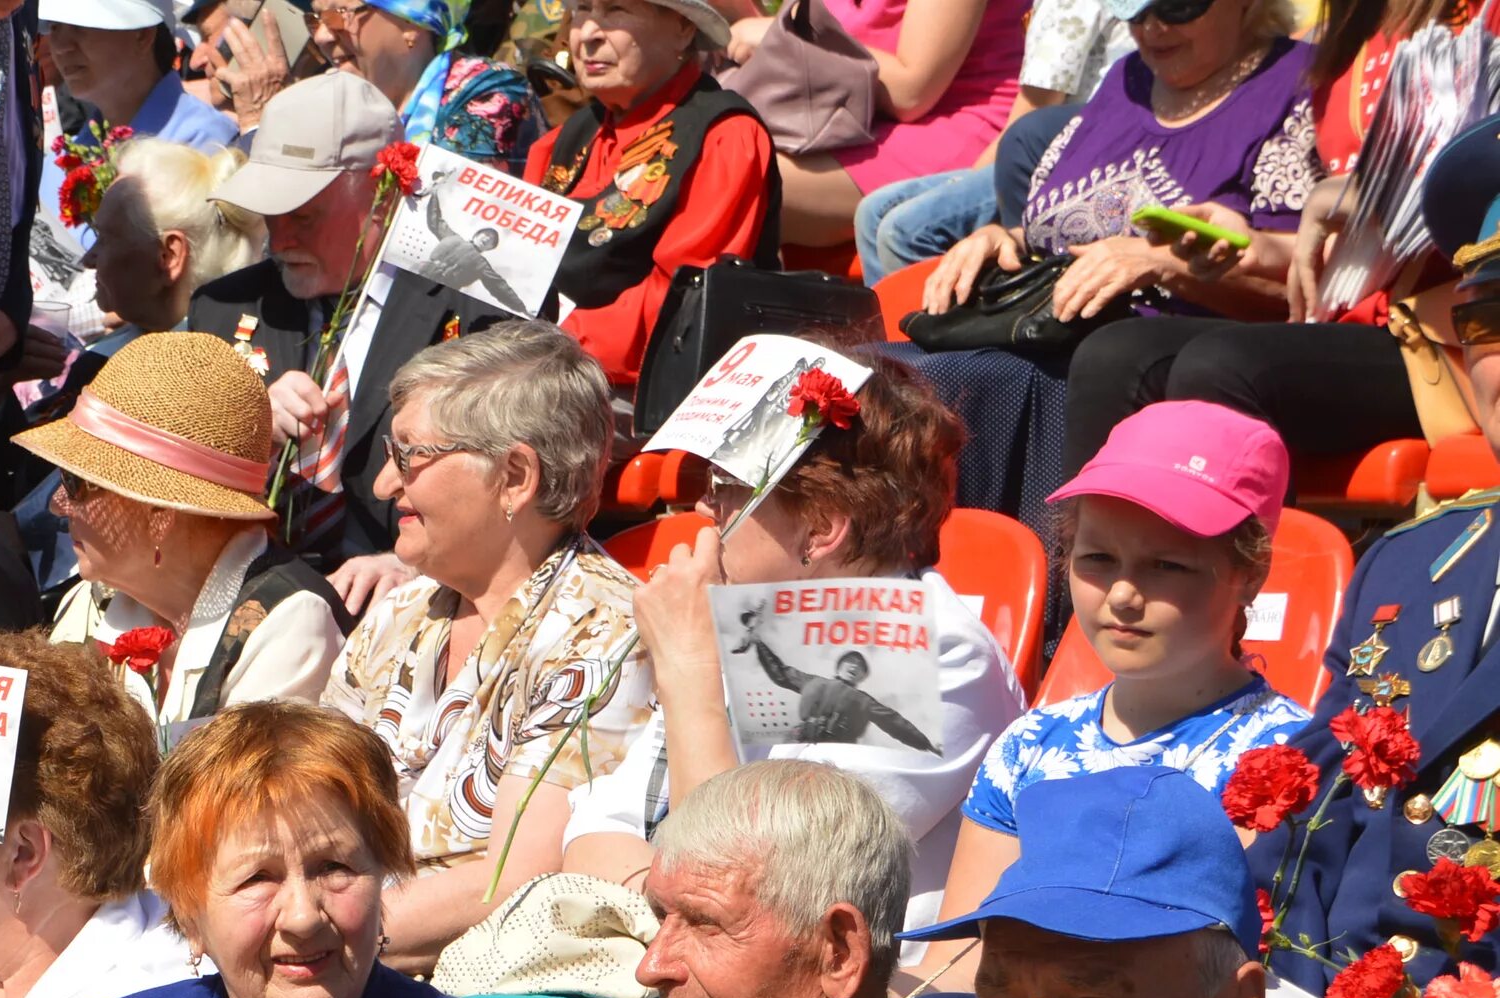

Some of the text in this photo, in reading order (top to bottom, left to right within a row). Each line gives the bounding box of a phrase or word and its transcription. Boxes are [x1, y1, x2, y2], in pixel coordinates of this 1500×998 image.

[457, 167, 571, 223] ВЕЛИКАЯ
[462, 197, 561, 249] ПОБЕДА
[702, 342, 764, 388] 9 мая
[773, 586, 925, 615] ВЕЛИКАЯ
[803, 620, 929, 654] ПОБЕДА
